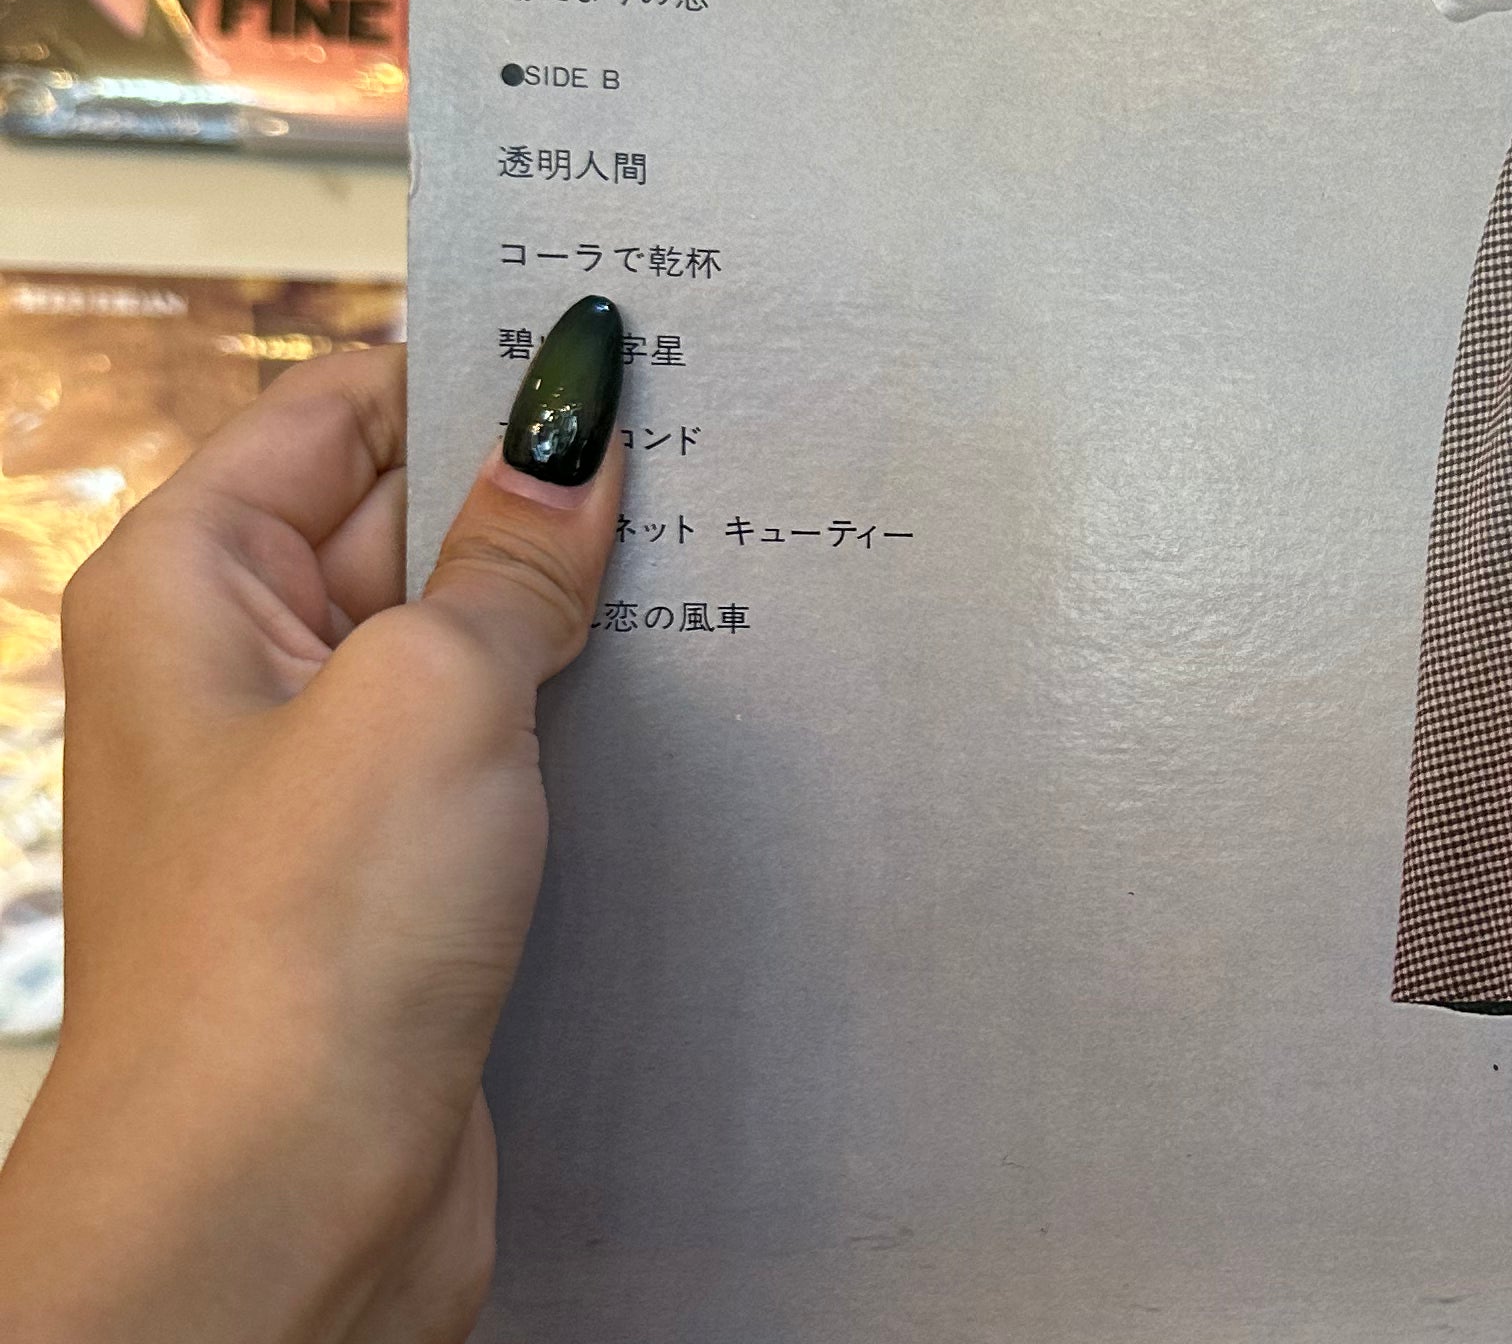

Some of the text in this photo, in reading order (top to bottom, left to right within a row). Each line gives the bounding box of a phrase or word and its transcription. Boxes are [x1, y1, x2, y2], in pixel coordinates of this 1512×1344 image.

[602, 69, 621, 90] B
[498, 145, 648, 186] 透明人間
[500, 242, 722, 280] コーラで乾杯
